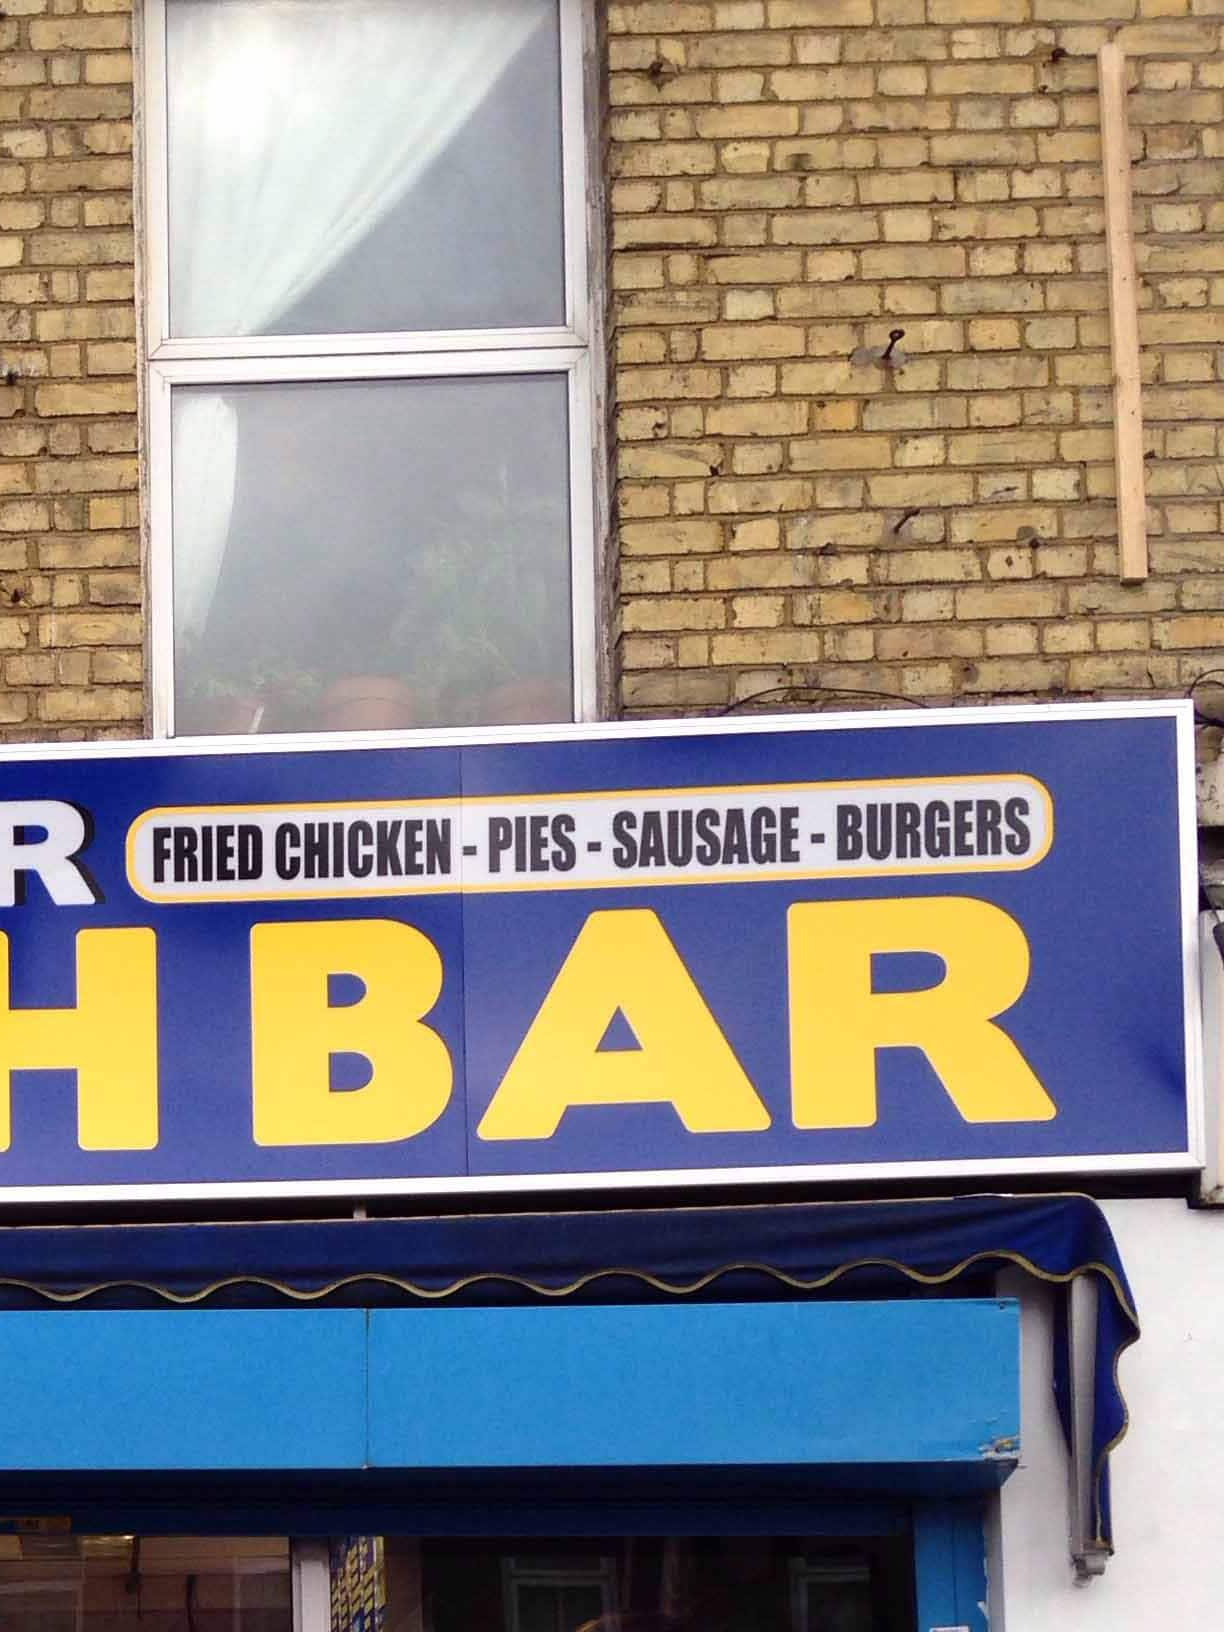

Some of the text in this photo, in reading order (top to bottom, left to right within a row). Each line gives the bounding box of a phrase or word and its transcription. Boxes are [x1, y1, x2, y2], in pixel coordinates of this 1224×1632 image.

[151, 823, 263, 884] FRIED
[274, 816, 452, 880] CHICKEN
[487, 812, 577, 874] PIES
[611, 804, 800, 868] SAUSAGE
[835, 797, 1031, 862] BURGERS
[250, 895, 1058, 1147] BAR
